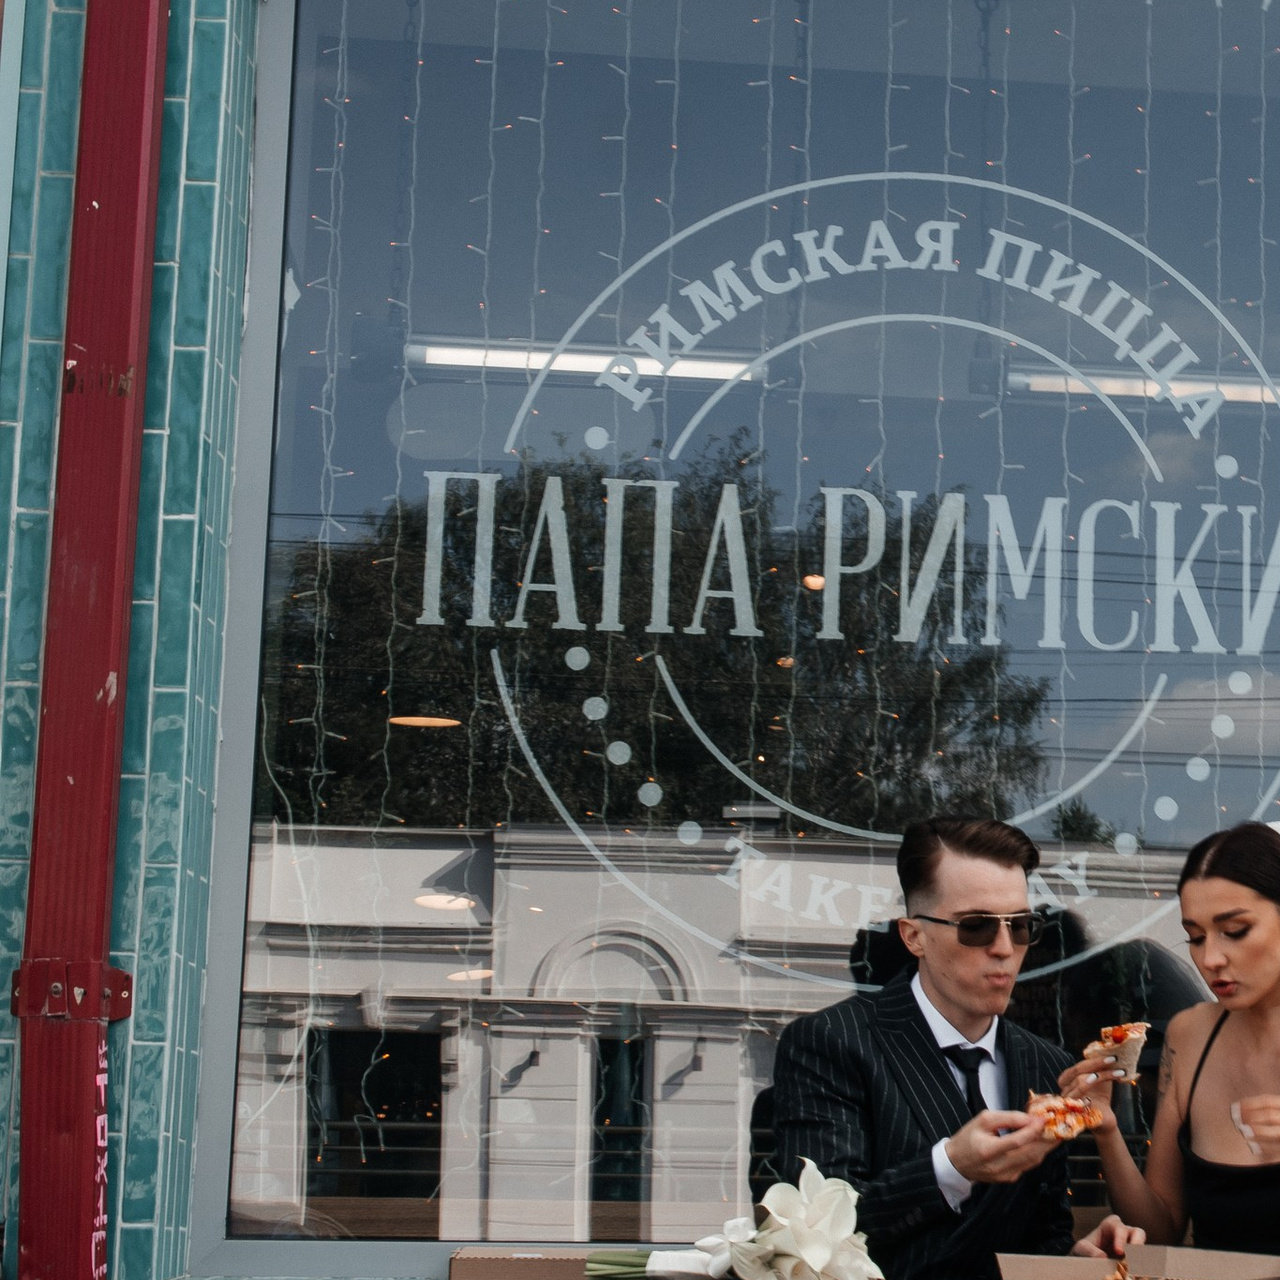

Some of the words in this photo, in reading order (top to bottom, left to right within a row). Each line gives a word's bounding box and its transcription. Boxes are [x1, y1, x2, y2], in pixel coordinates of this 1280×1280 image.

[594, 219, 960, 413] РИМСКАЯ
[976, 228, 1227, 440] ПИЦЦА
[416, 470, 764, 637] ПАПА
[715, 836, 894, 933] TAKE
[1027, 851, 1099, 916] AY
